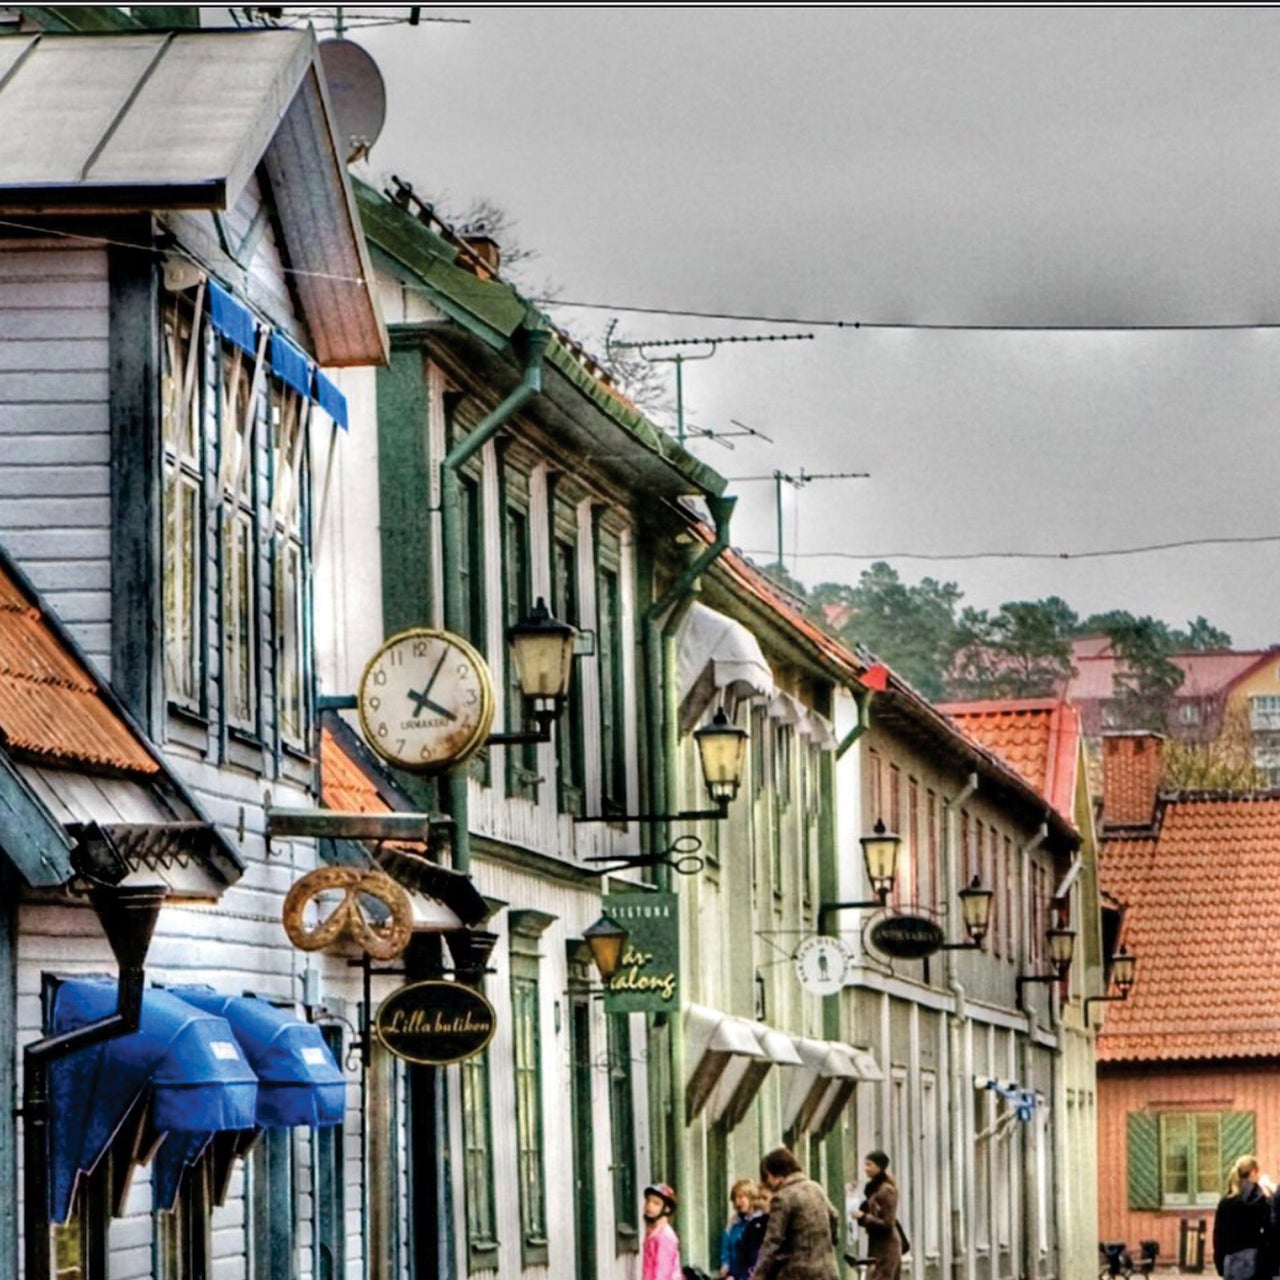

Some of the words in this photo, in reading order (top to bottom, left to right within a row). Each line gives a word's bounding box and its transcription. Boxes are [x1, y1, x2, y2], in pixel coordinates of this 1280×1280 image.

[390, 650, 402, 666] 11
[412, 641, 428, 658] 12
[373, 669, 387, 686] 10
[457, 663, 469, 680] 2
[369, 697, 381, 712] 9
[466, 689, 478, 706] 3
[377, 721, 389, 738] 8
[395, 738, 406, 755] 7
[420, 744, 432, 760] 6
[610, 905, 670, 919] SIGTUNA
[381, 1009, 431, 1034] Lilla
[434, 1010, 490, 1034] butiken
